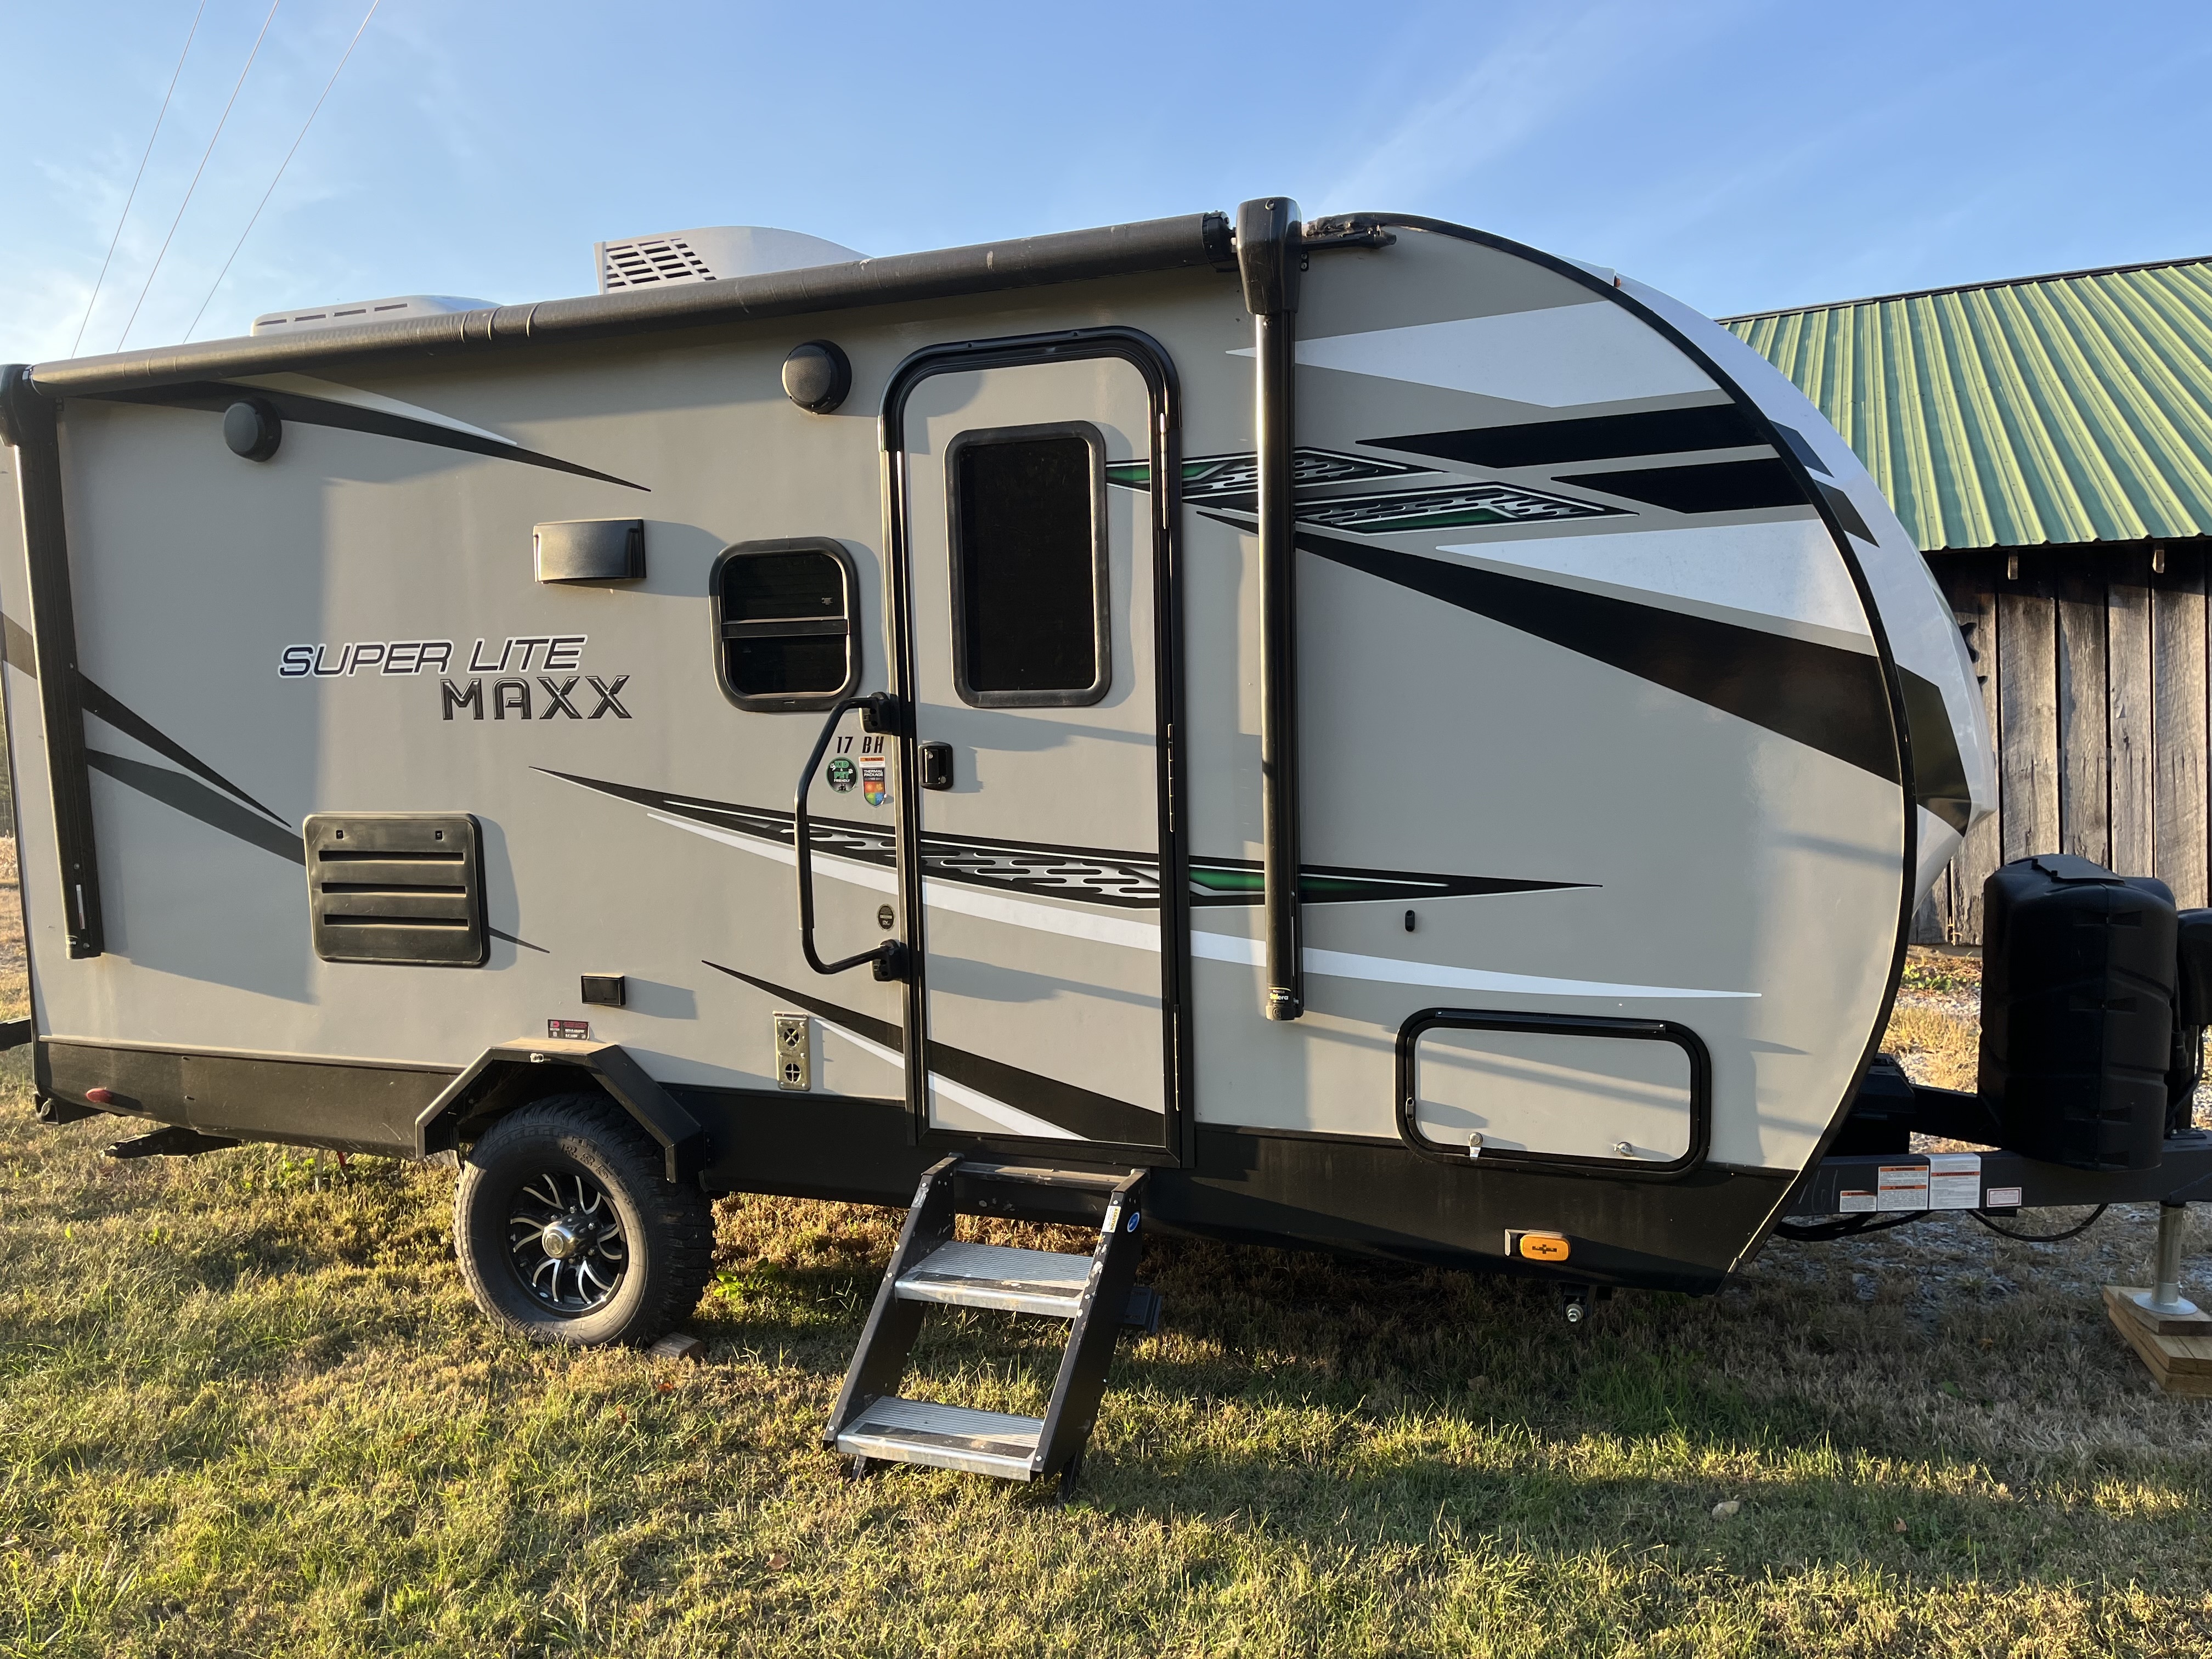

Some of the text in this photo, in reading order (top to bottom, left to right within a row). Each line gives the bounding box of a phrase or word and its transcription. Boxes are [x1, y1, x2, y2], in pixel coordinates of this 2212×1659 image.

[278, 634, 588, 678] SUPER LITE
[439, 675, 633, 721] MAXX
[837, 736, 884, 754] 17 BH
[834, 760, 849, 769] KID
